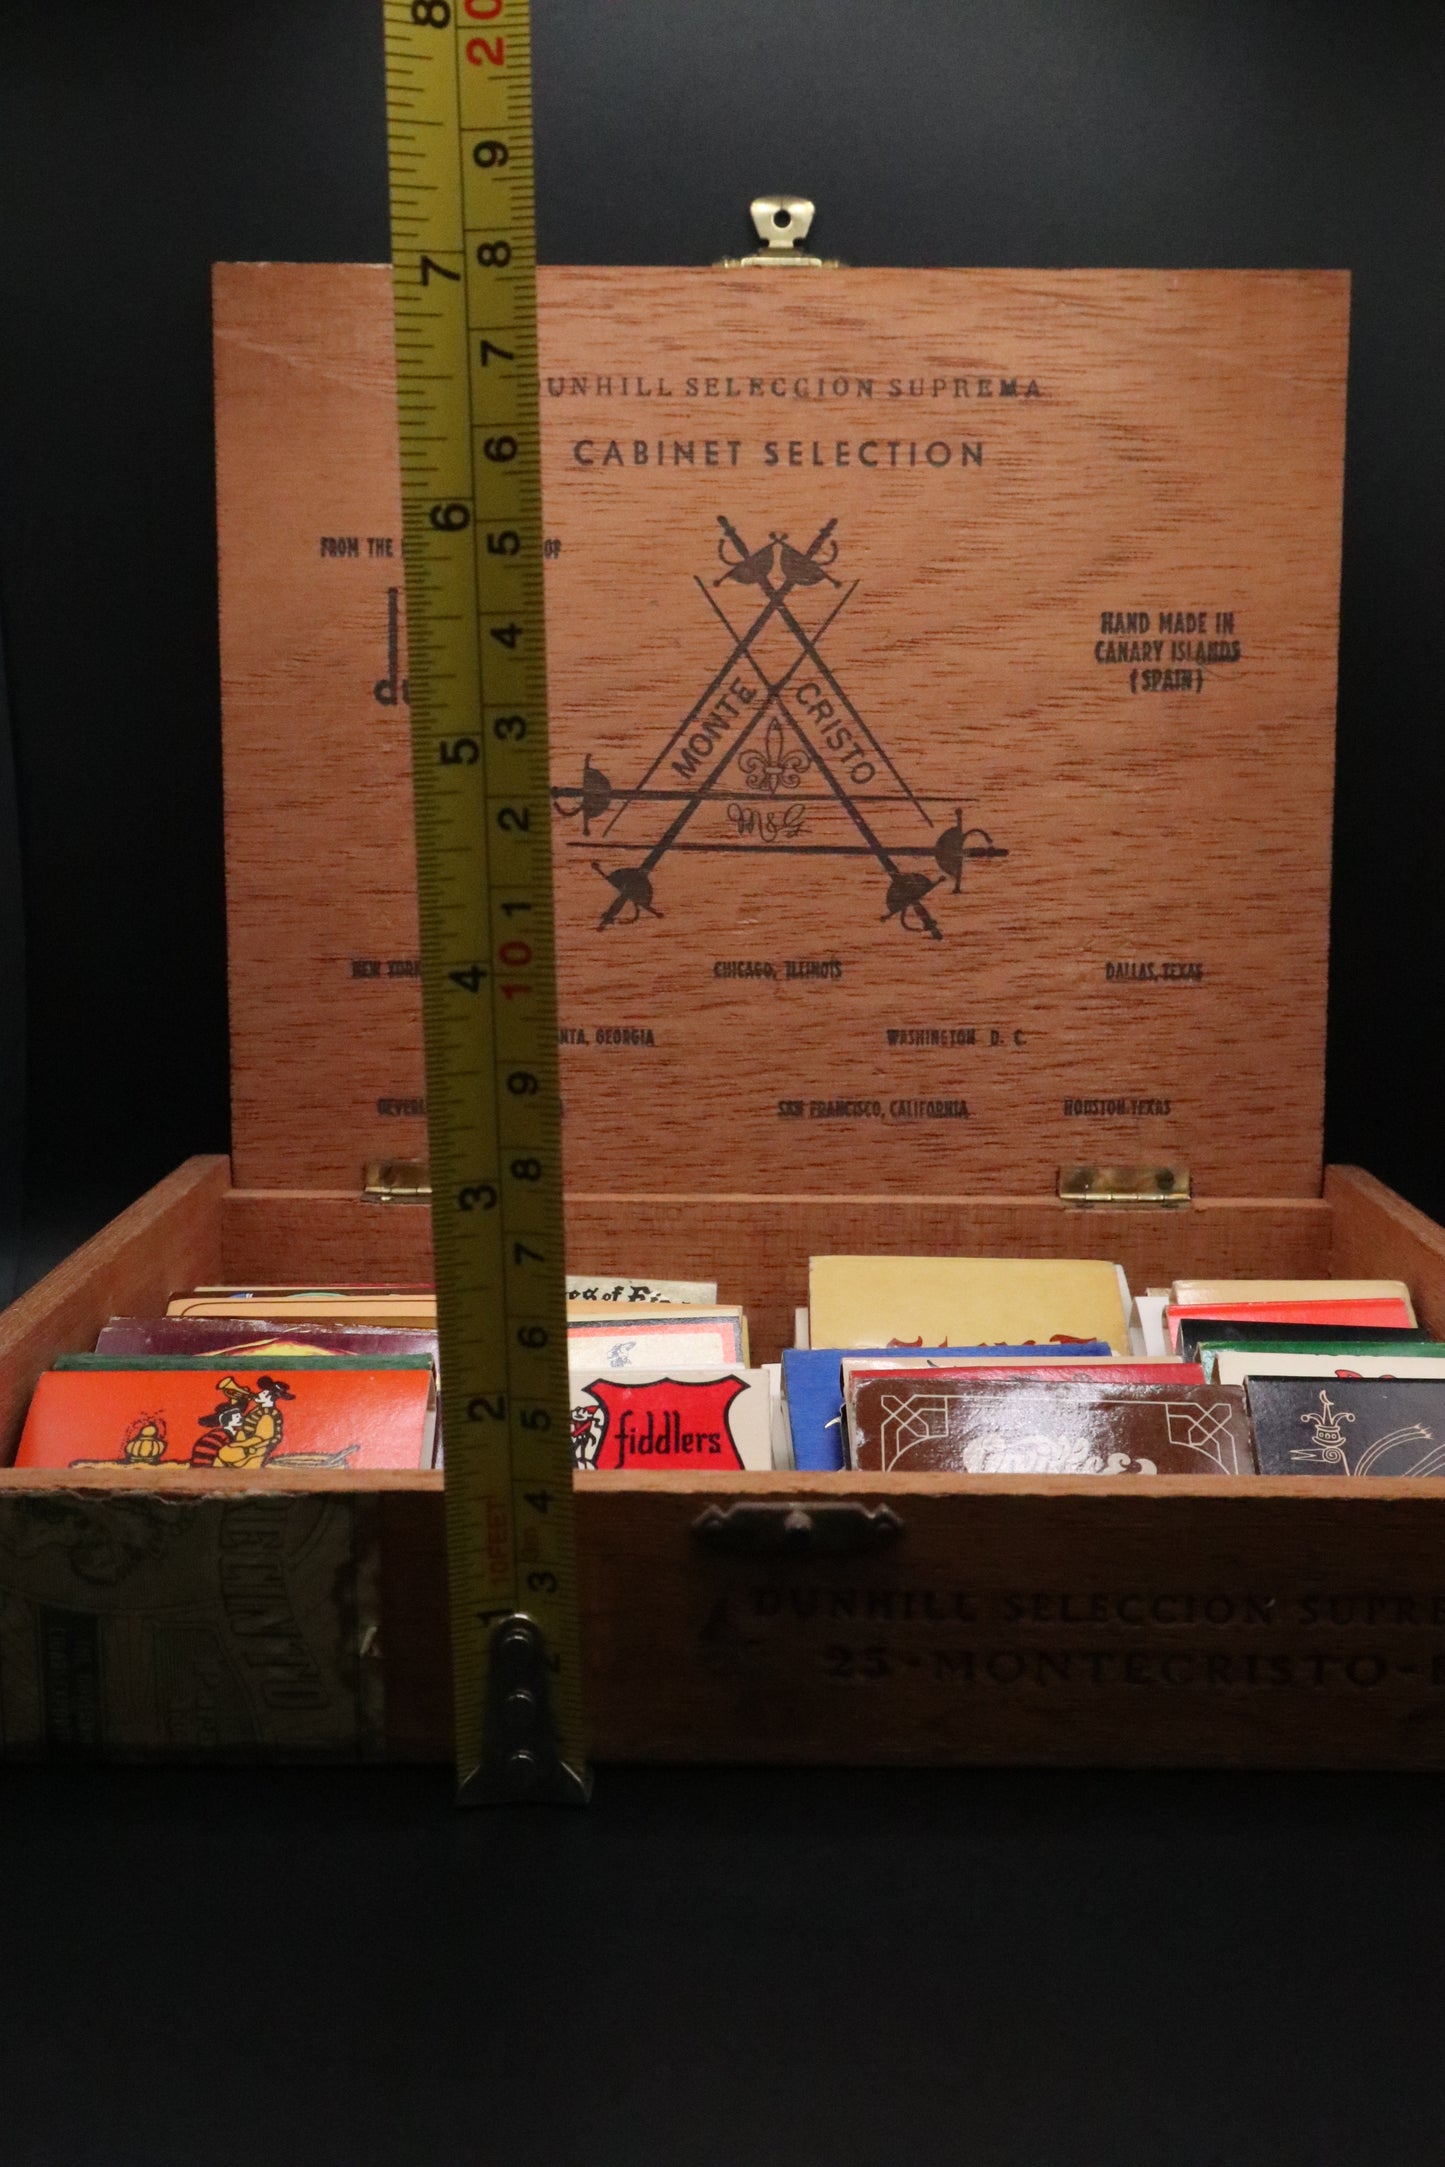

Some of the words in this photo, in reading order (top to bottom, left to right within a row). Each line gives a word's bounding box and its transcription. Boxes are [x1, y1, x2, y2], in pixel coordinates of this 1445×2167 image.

[410, 0, 452, 29] 8
[473, 140, 509, 168] 9
[477, 240, 512, 268] 8
[420, 254, 461, 287] 7
[480, 340, 514, 367] 7
[539, 377, 673, 398] UNHILL
[888, 378, 1041, 399] SUPREMA
[484, 435, 518, 463] 6
[573, 439, 742, 466] CABINET
[764, 439, 983, 467] SELECTION
[430, 502, 471, 532] 6
[320, 536, 359, 558] FROM
[367, 537, 394, 558] THE
[486, 530, 521, 556] 5
[490, 622, 523, 649] 4
[1100, 611, 1150, 635] HAND
[1159, 611, 1207, 634] MADE
[1215, 611, 1234, 635] IN
[1094, 640, 1164, 664] CANARY
[1171, 640, 1241, 664] ISLANDS
[494, 714, 527, 741] 3
[671, 677, 758, 780] MONTE
[796, 682, 877, 785] CRISTO
[438, 736, 480, 766] 5
[498, 807, 531, 833] 2
[501, 901, 532, 918] 1
[448, 965, 488, 994] 4
[500, 941, 533, 1000] 10
[595, 1028, 655, 1047] GEORGIA
[887, 1029, 975, 1046] WASHINGTON
[507, 1071, 539, 1096] 9
[511, 1157, 542, 1182] 8
[458, 1183, 498, 1212] 3
[514, 1242, 546, 1266] 7
[516, 1325, 549, 1349] 6
[467, 1396, 506, 1422] 2
[519, 1408, 550, 1432] 5
[614, 1410, 722, 1469] fiddlers
[522, 1489, 552, 1514] 4
[526, 1571, 558, 1594] 3
[752, 1587, 977, 1621] DUNHILL
